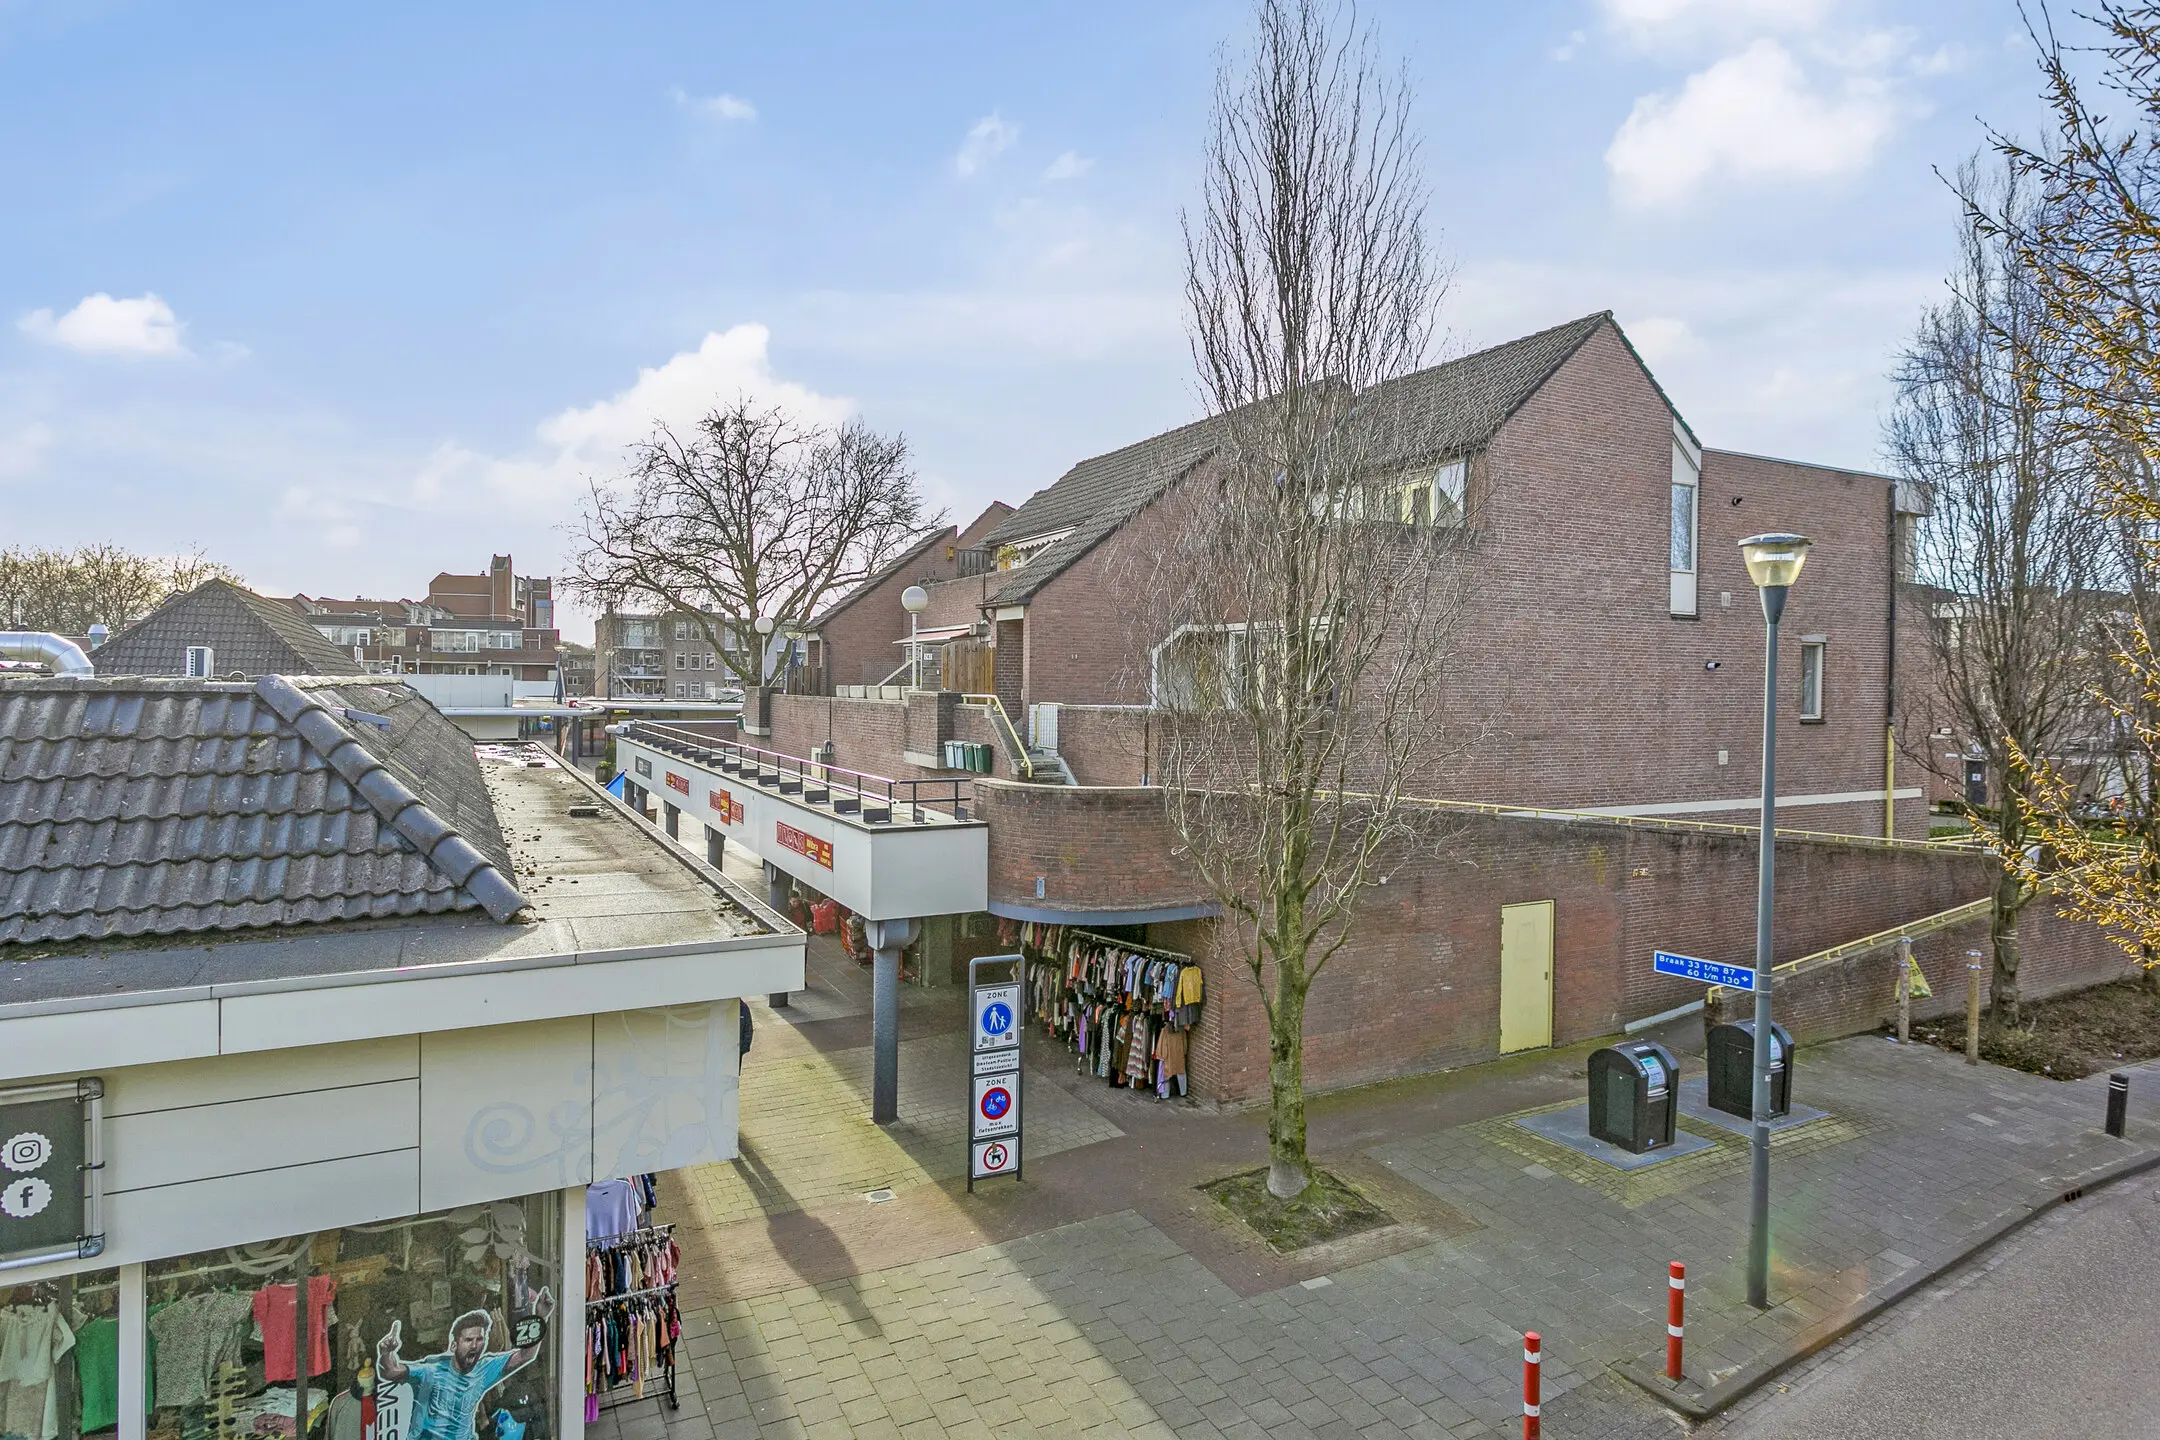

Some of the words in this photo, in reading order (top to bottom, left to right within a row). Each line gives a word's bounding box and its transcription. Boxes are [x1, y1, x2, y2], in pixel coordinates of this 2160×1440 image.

[1659, 955, 1684, 966] Braak
[1688, 961, 1700, 969] 33
[1704, 964, 1719, 973] t/m
[1723, 968, 1735, 976] 87
[1687, 969, 1699, 977] 60
[1704, 972, 1719, 981] t/m
[1722, 976, 1740, 985] 130
[987, 991, 1008, 999] ZONE
[986, 1078, 1007, 1087] ZONE
